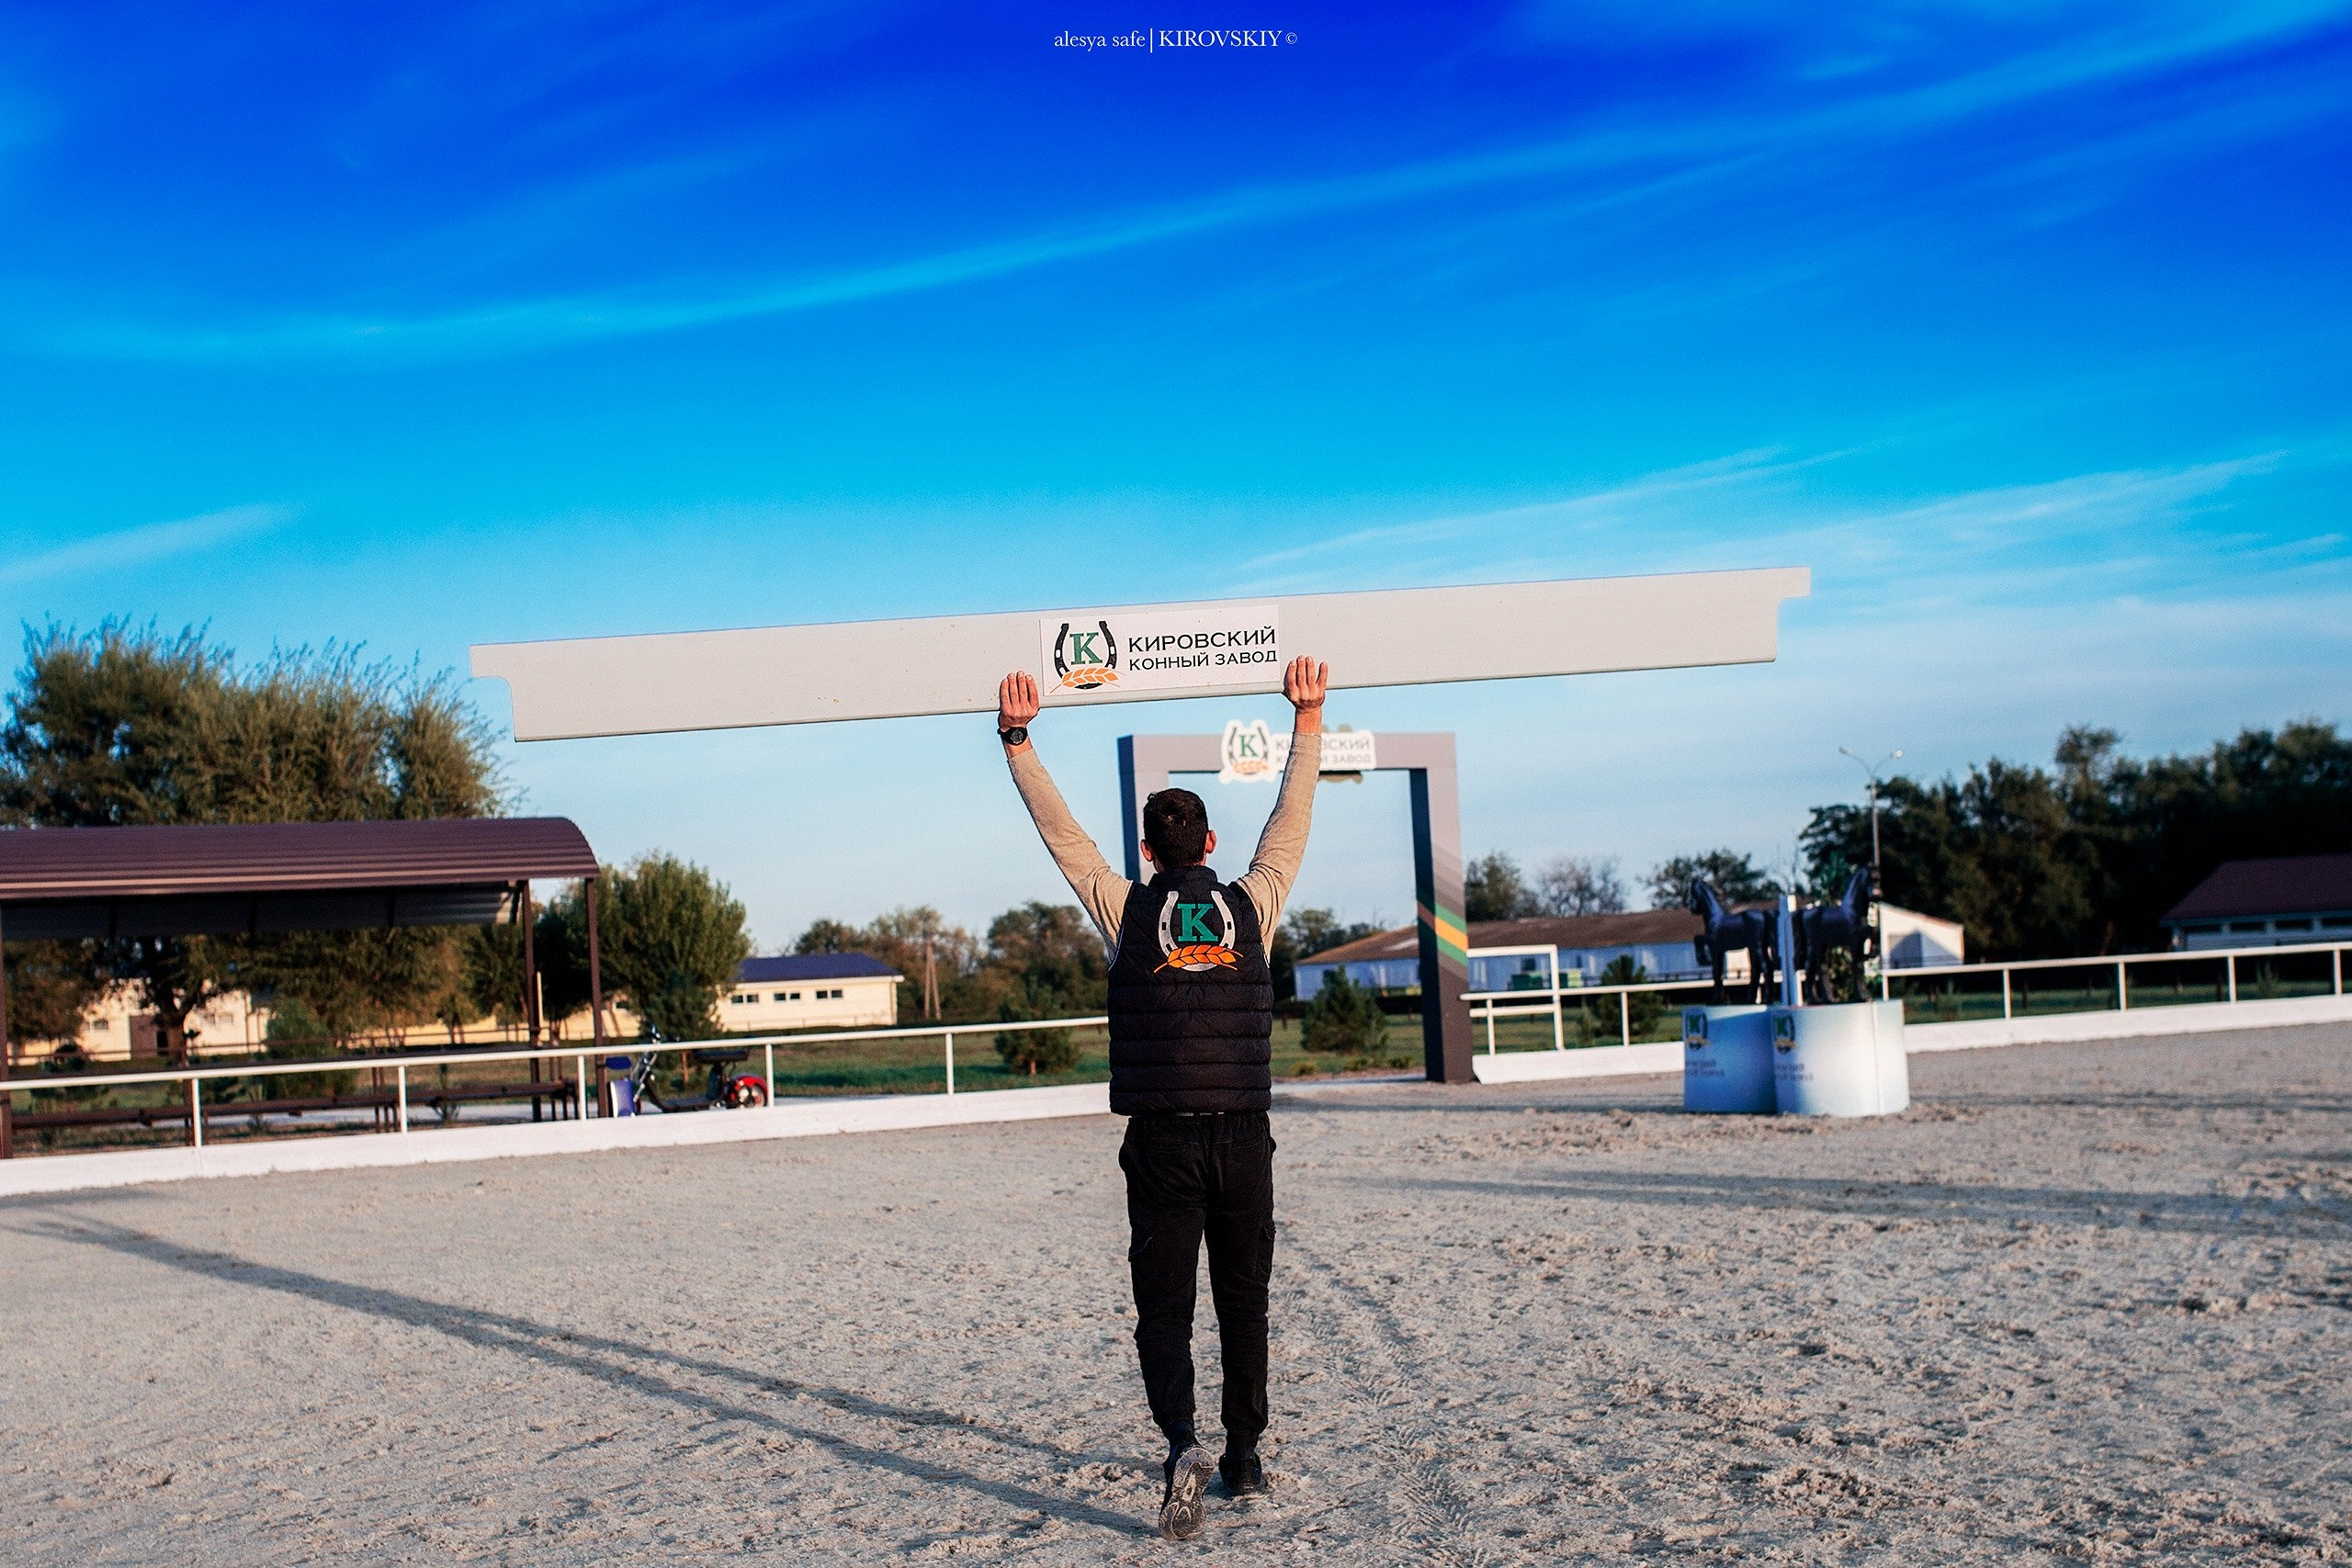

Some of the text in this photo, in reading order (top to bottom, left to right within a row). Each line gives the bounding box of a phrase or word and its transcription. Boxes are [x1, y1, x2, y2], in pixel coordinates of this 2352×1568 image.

[1069, 632, 1103, 665] К
[1128, 626, 1276, 652] КИРОВСКИЙ
[1129, 649, 1278, 671] КОННЫЙ ЗАВОД
[1177, 903, 1219, 942] К
